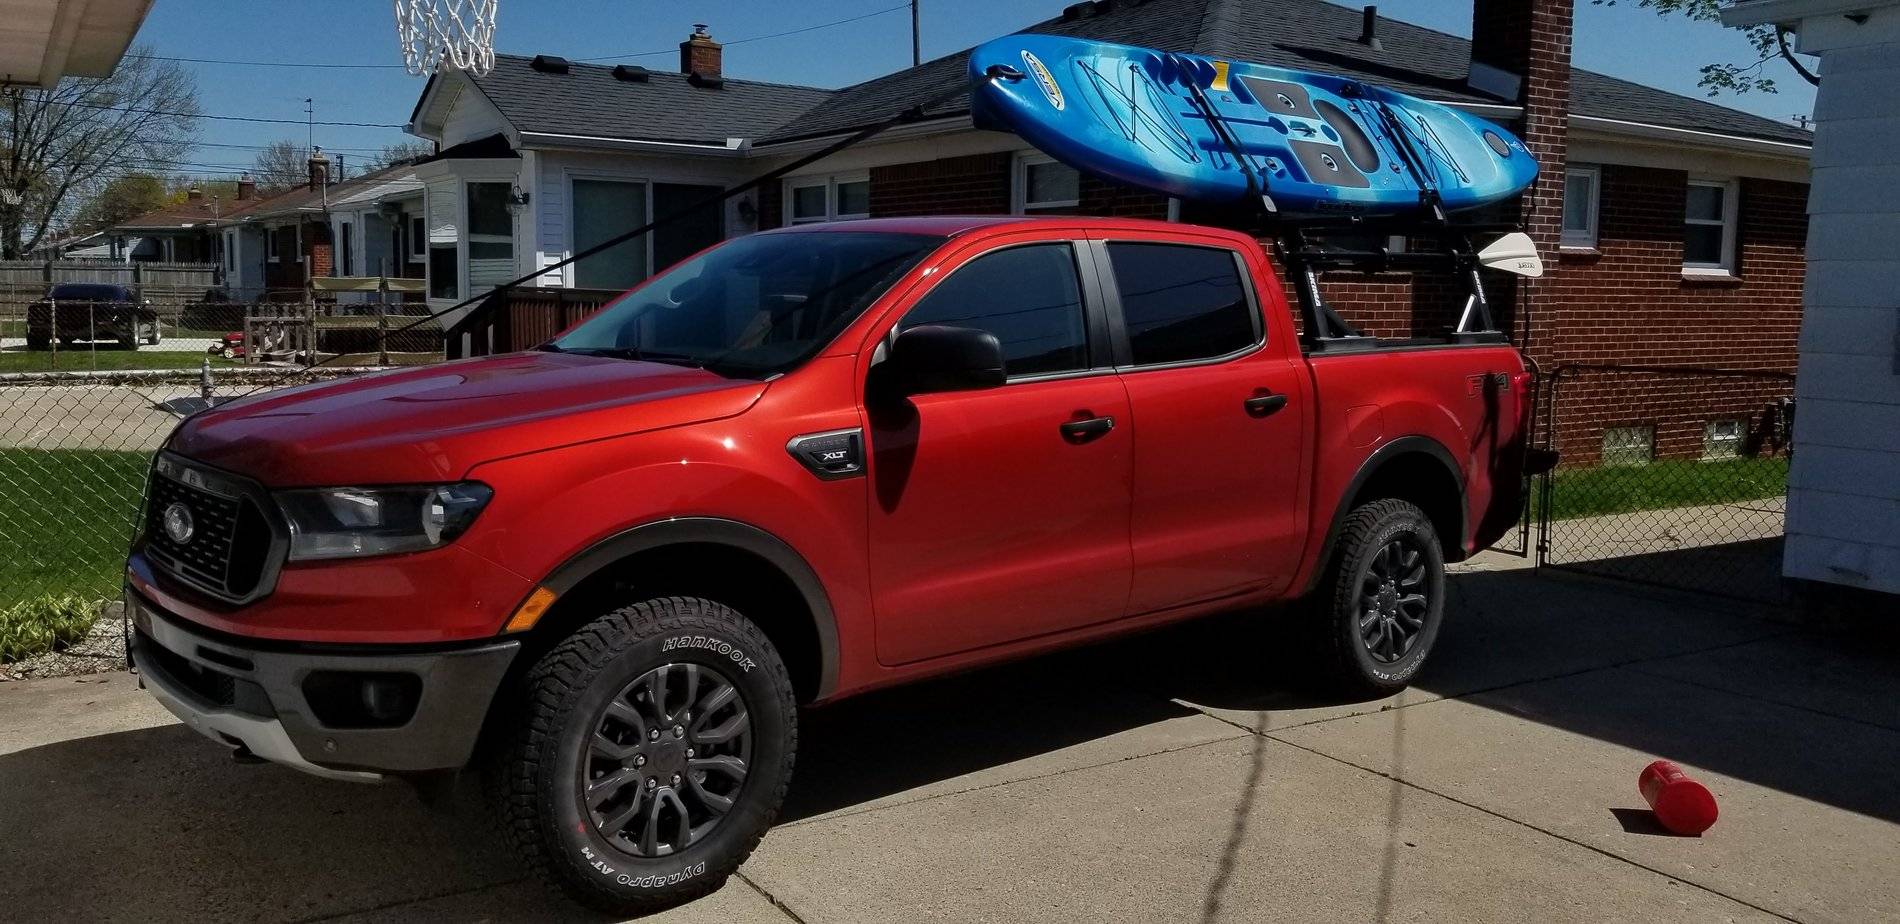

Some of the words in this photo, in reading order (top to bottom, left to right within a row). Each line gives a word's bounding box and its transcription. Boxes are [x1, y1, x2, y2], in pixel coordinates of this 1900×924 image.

[1464, 370, 1510, 399] F4
[822, 450, 847, 461] XLT
[662, 636, 756, 673] Hankook
[616, 861, 705, 888] Dynapro
